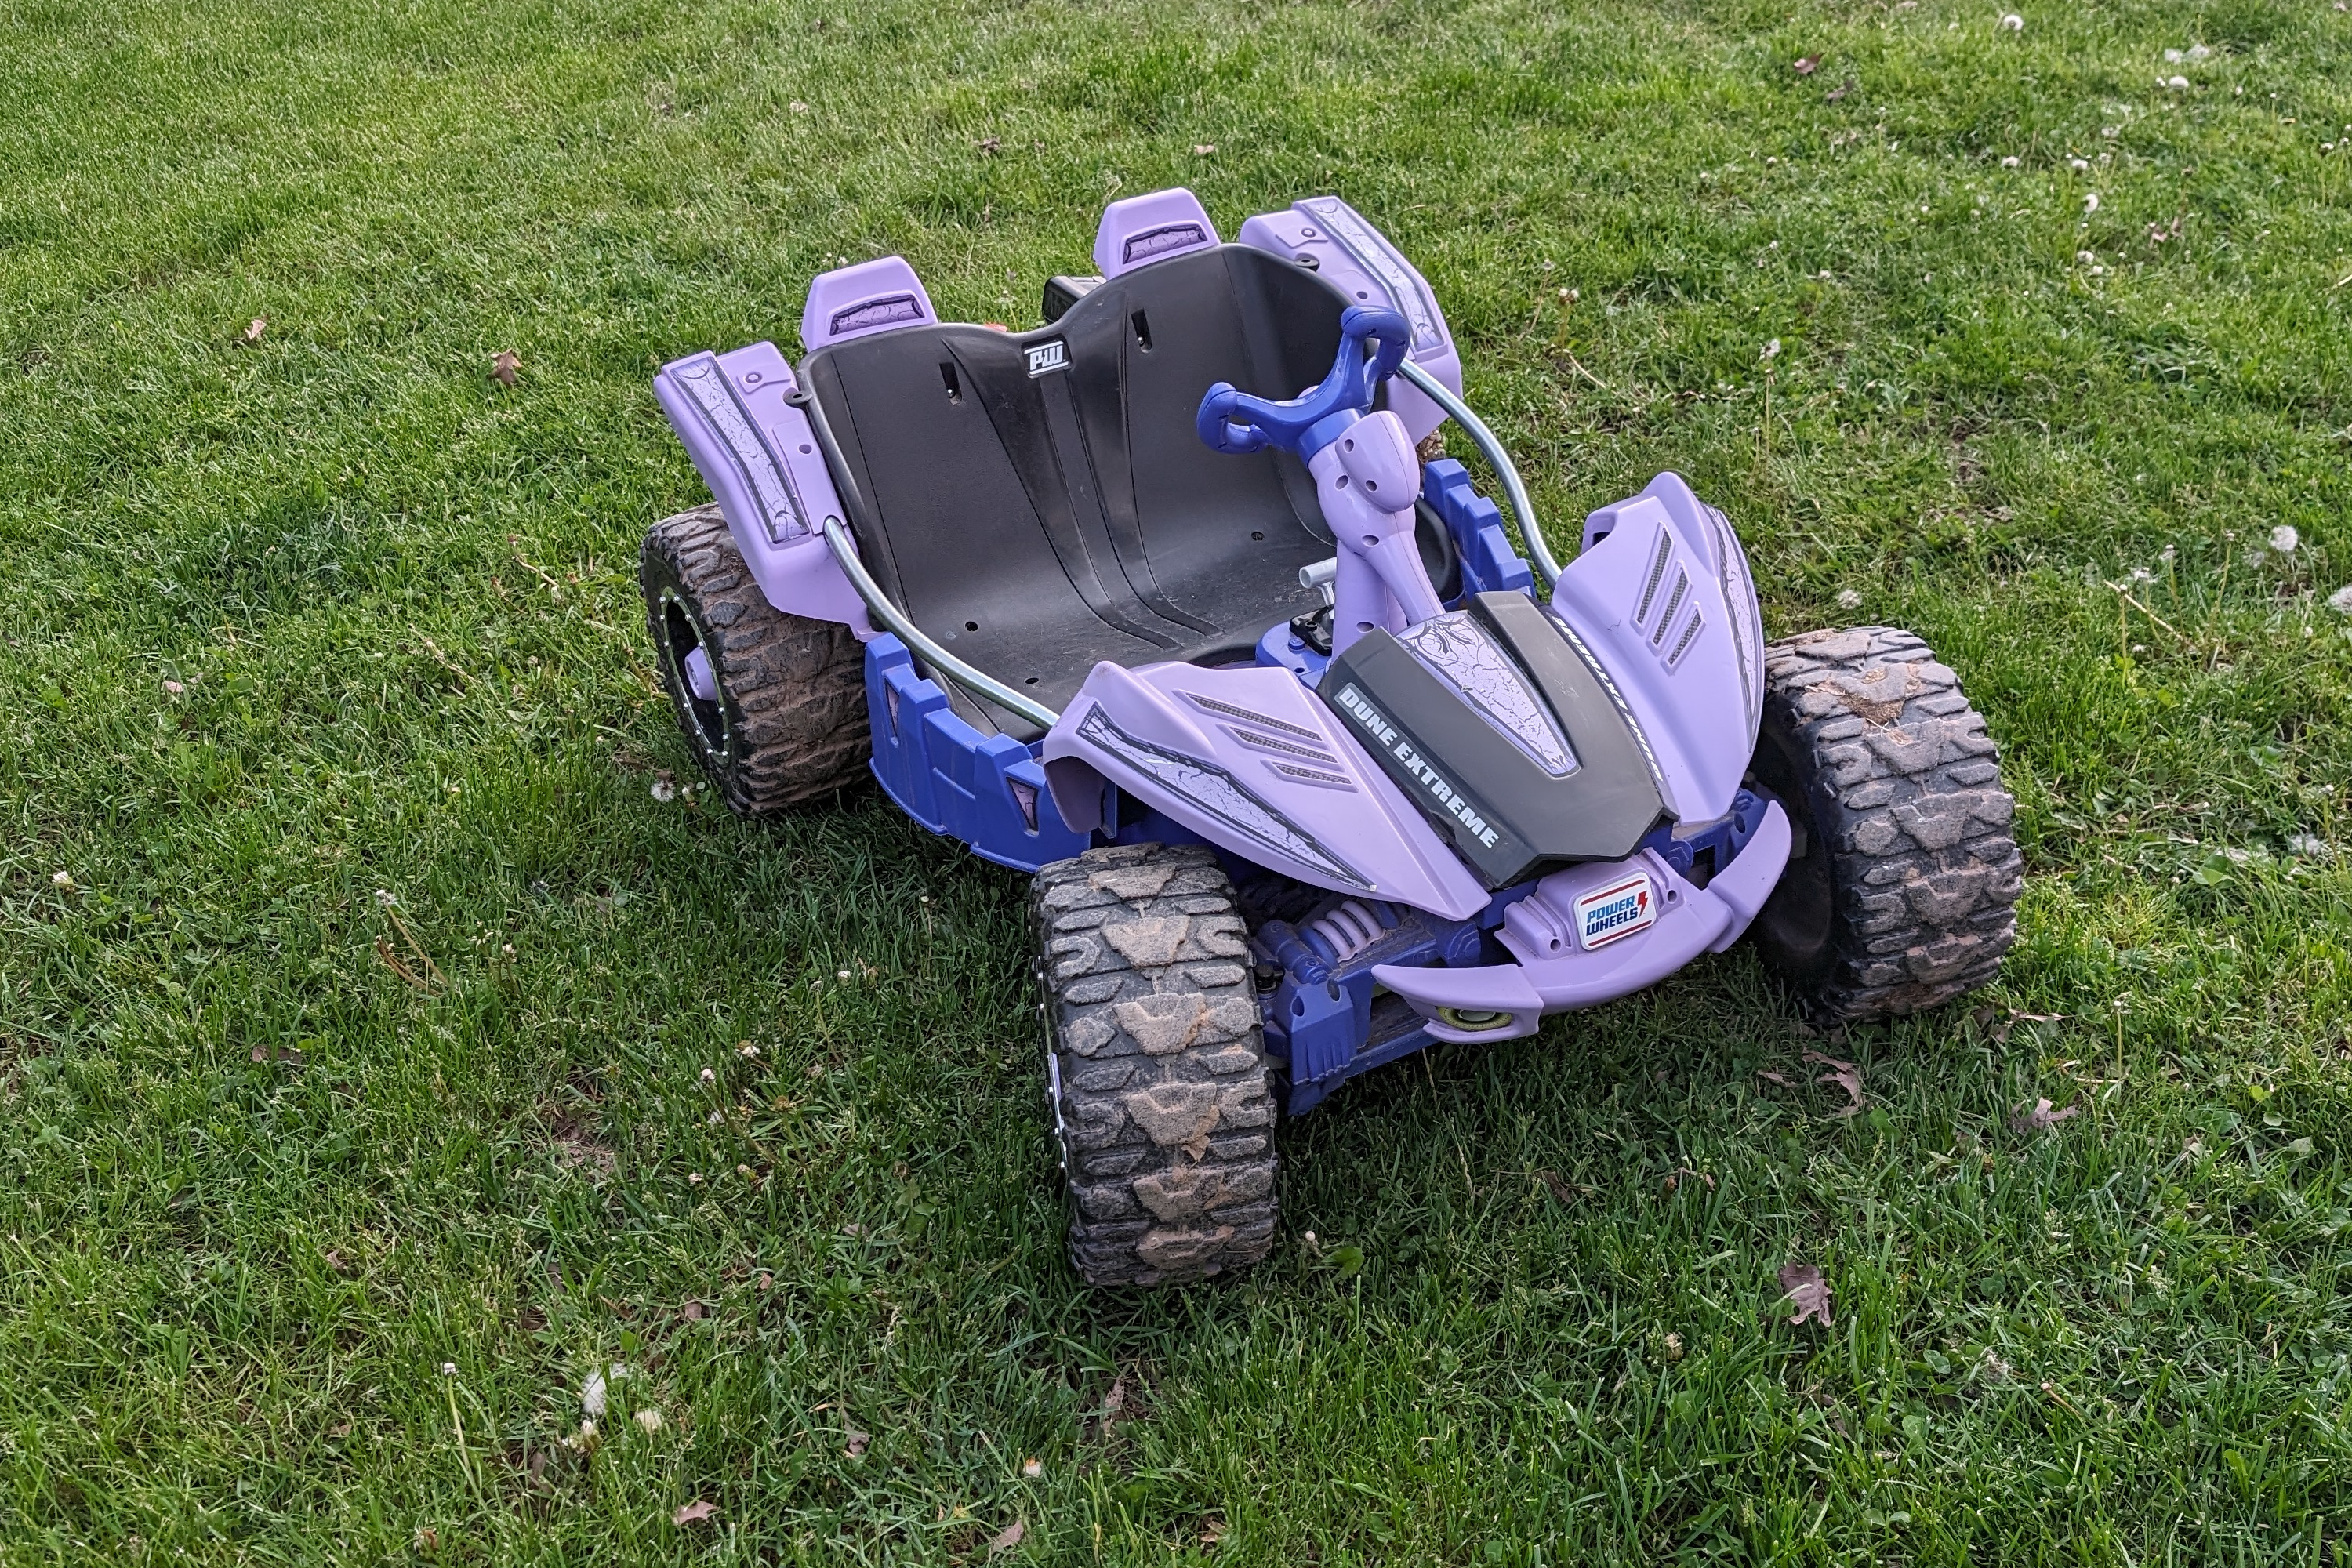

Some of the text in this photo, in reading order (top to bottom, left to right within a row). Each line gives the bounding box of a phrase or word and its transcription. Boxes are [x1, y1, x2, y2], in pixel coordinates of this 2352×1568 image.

[1030, 345, 1063, 371] PW
[1552, 615, 1663, 782] DUNE EXTREME
[1339, 688, 1500, 848] DUNE EXTREME
[1586, 907, 1638, 936] WHEELS
[1587, 895, 1635, 924] POWER
